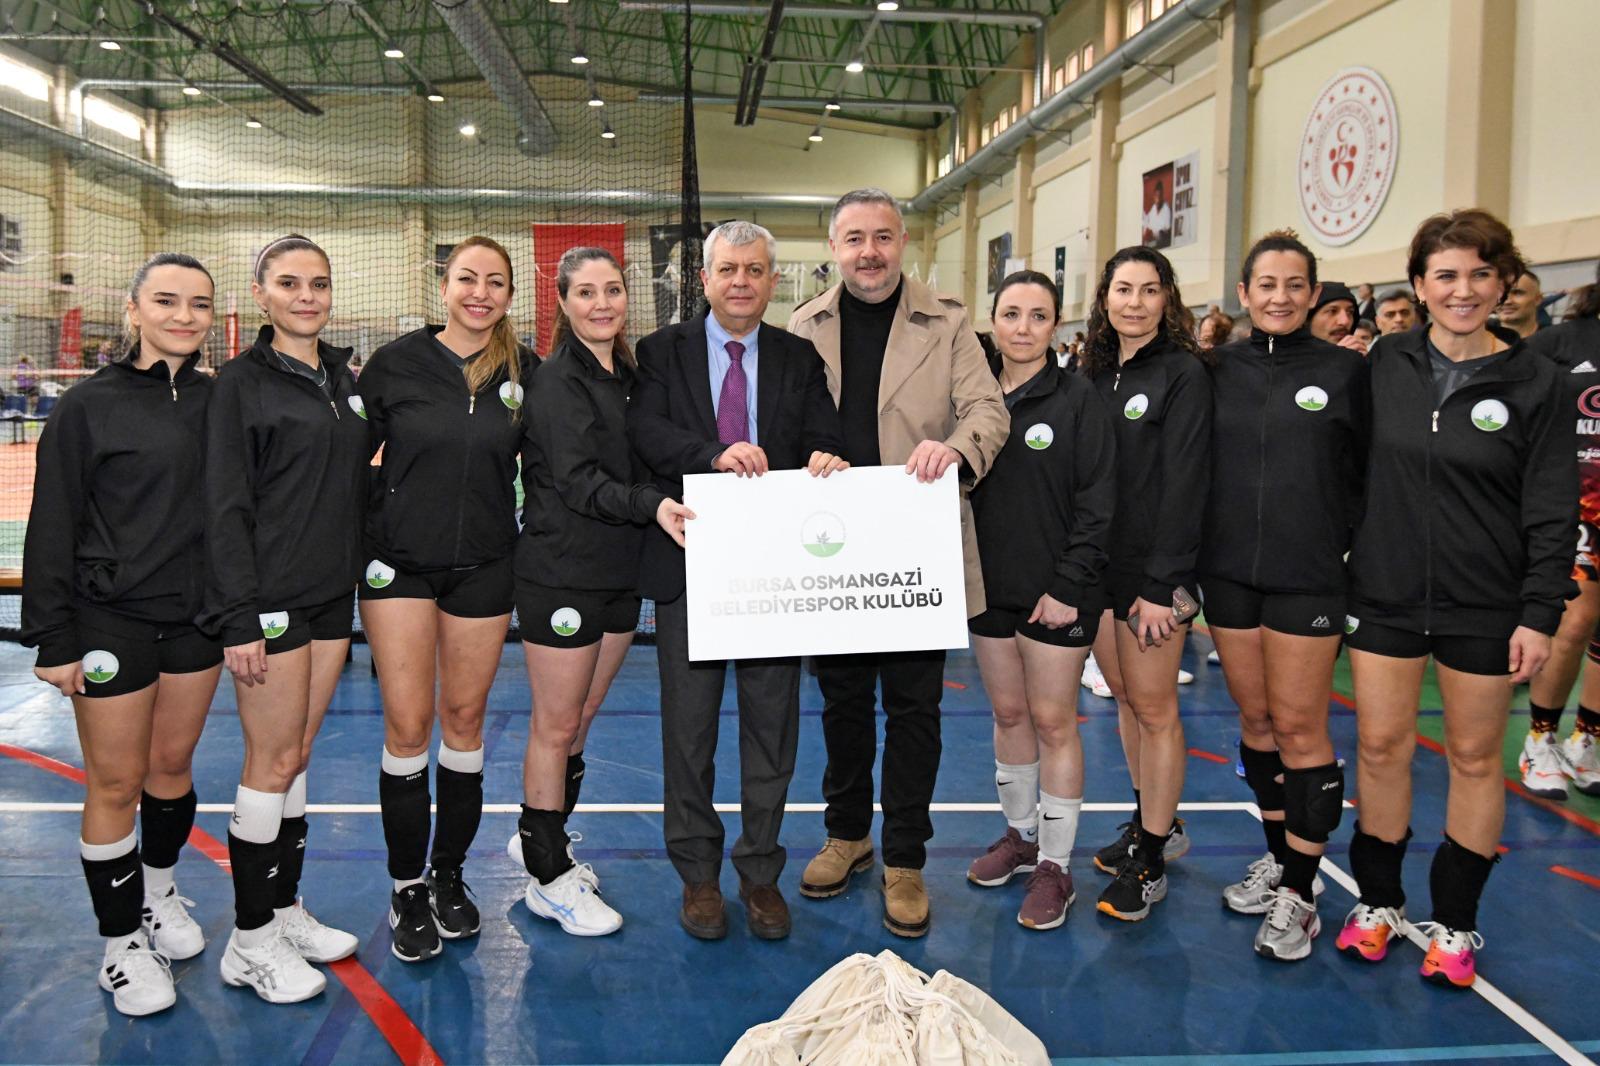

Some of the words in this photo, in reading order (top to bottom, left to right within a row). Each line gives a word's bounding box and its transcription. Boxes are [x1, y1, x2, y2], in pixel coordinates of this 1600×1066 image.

[728, 576, 796, 595] BURSA
[801, 567, 922, 591] OSMANGAZİ
[710, 593, 859, 617] BELEDİYESPOR
[863, 588, 943, 610] KULÜBÜ
